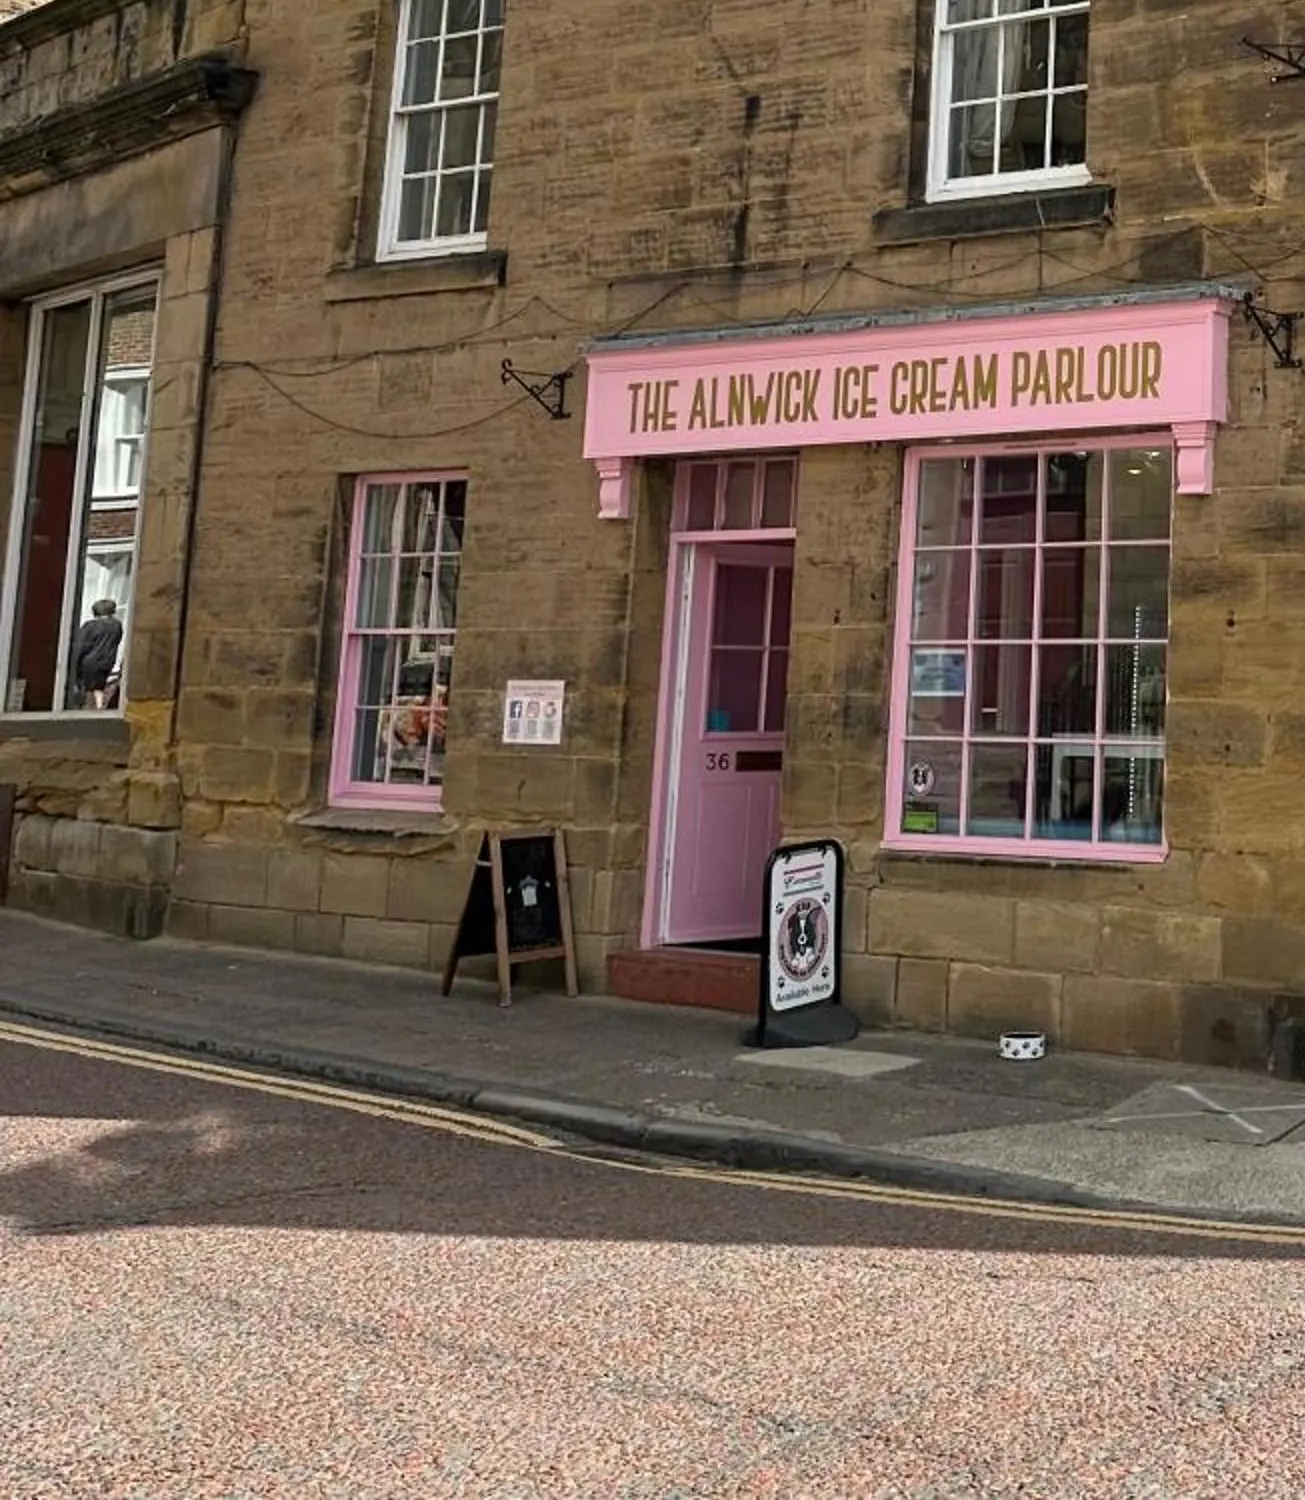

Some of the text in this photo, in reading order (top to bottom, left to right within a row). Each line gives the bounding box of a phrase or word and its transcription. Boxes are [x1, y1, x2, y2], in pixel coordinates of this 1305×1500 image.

[628, 341, 1162, 433] THE ALNWICK ICE CREAM PARLOUR
[706, 753, 730, 771] 36
